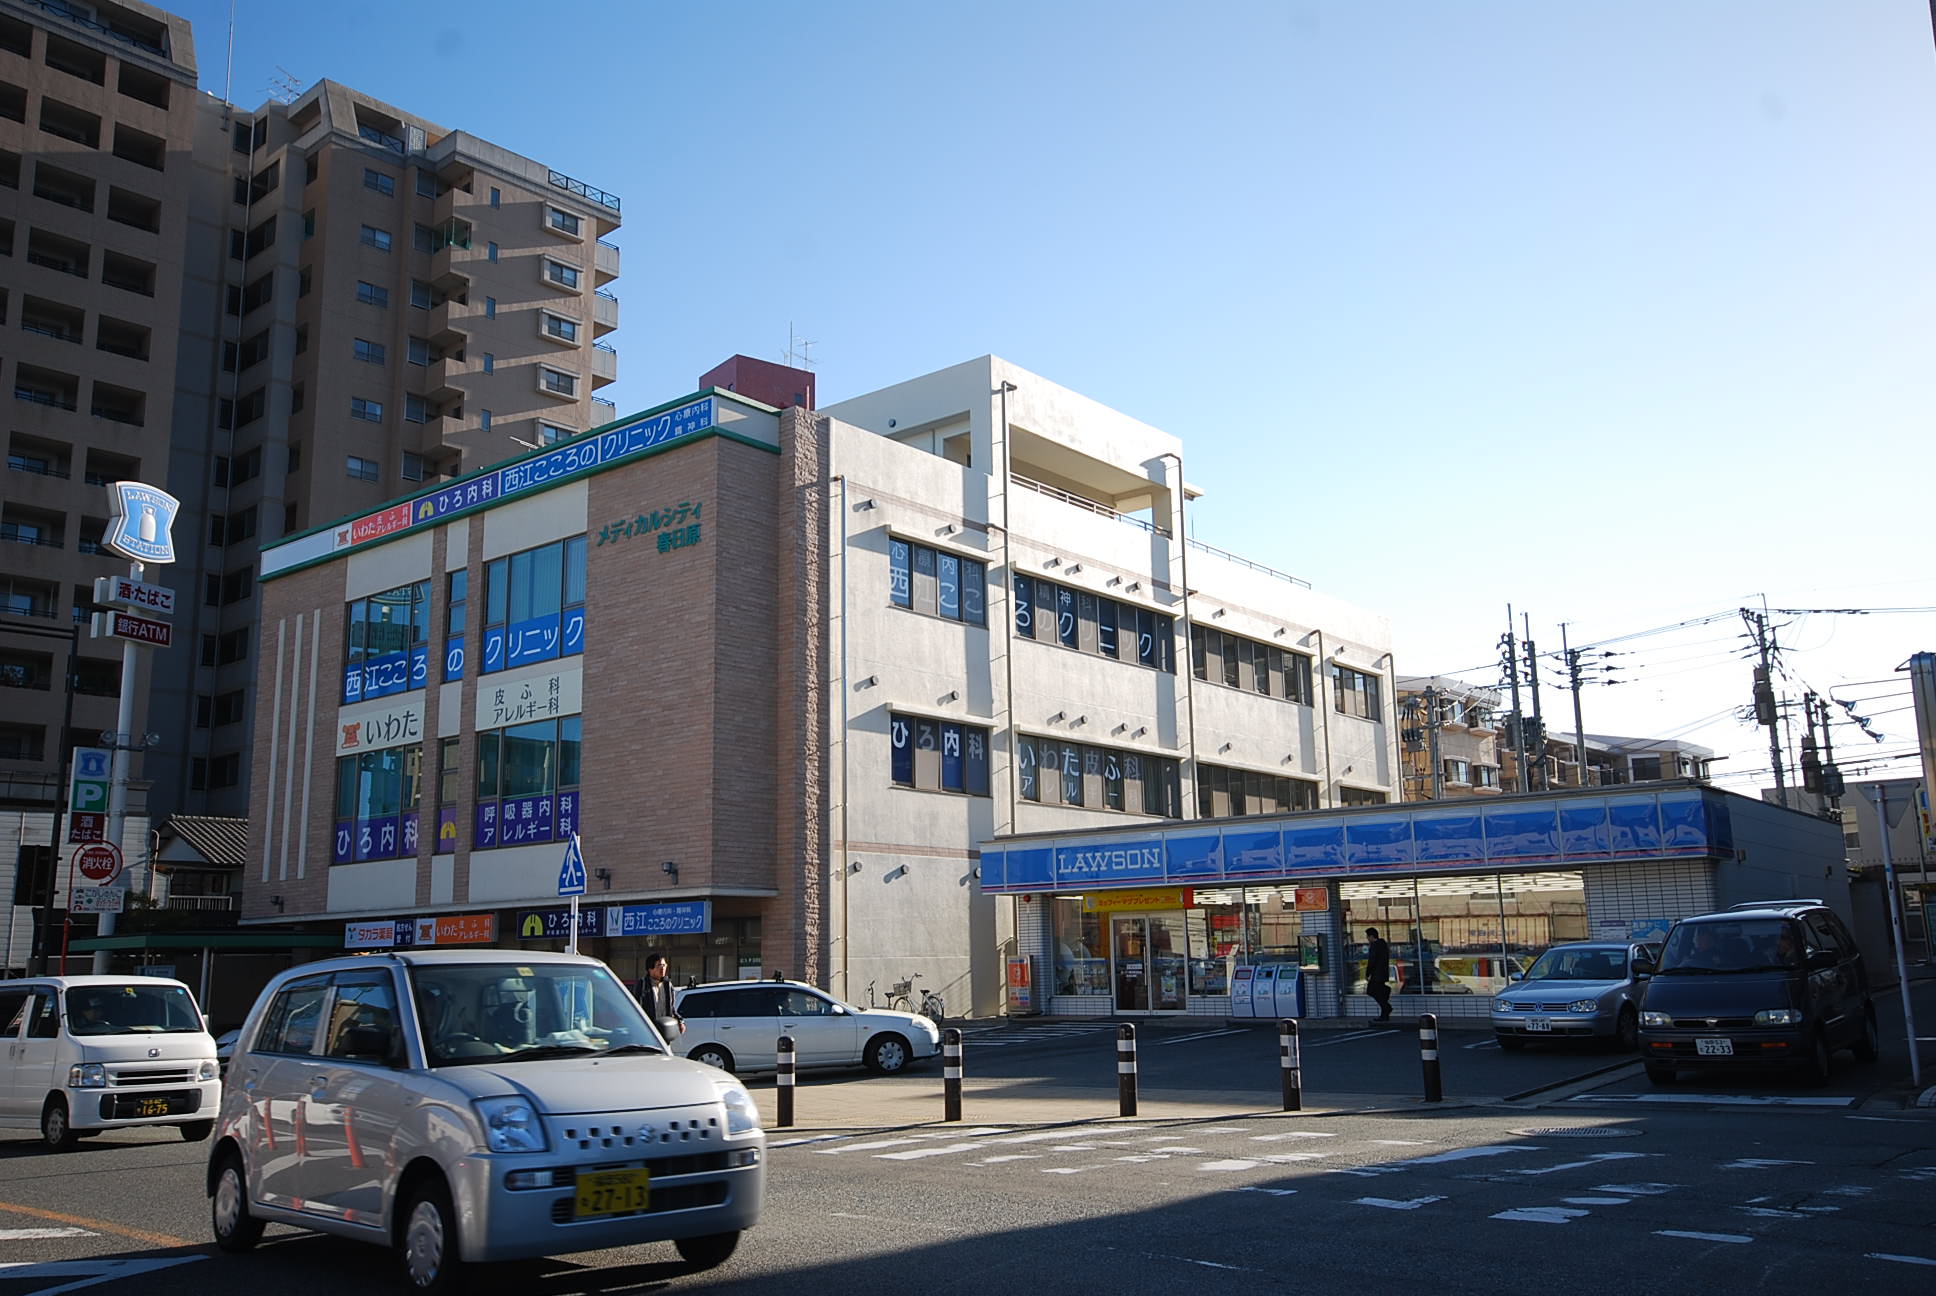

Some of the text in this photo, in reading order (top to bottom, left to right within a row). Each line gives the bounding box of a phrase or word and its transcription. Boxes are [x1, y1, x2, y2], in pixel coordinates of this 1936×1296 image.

[504, 415, 671, 493] 西江こころの クリニック
[127, 490, 173, 513] LAWSON
[438, 478, 493, 513] ひろ内科
[352, 520, 377, 540] いわた
[596, 501, 703, 547] メディカルシティ
[122, 533, 169, 555] STATION
[656, 522, 702, 555] 春日原
[117, 618, 168, 641] 銀行ATM
[345, 615, 583, 697] 西江こころ の クリニック
[494, 676, 560, 706] 皮ふ科
[494, 696, 560, 725] アレルギー科
[366, 710, 418, 744] いわた
[892, 721, 984, 761] ひろ内科
[76, 783, 103, 809] P
[484, 795, 573, 823] 呼吸器内科
[71, 829, 102, 840] たばこ
[337, 818, 419, 856] ひろ内科
[483, 817, 572, 844] アレルギー科
[82, 857, 112, 870] 消火栓
[1058, 848, 1161, 874] LAWSON
[436, 925, 458, 936] いわた
[624, 912, 703, 931] 西江 こころのクリニック
[1705, 1045, 1731, 1054] 22-33
[592, 1185, 645, 1211] 27-13
